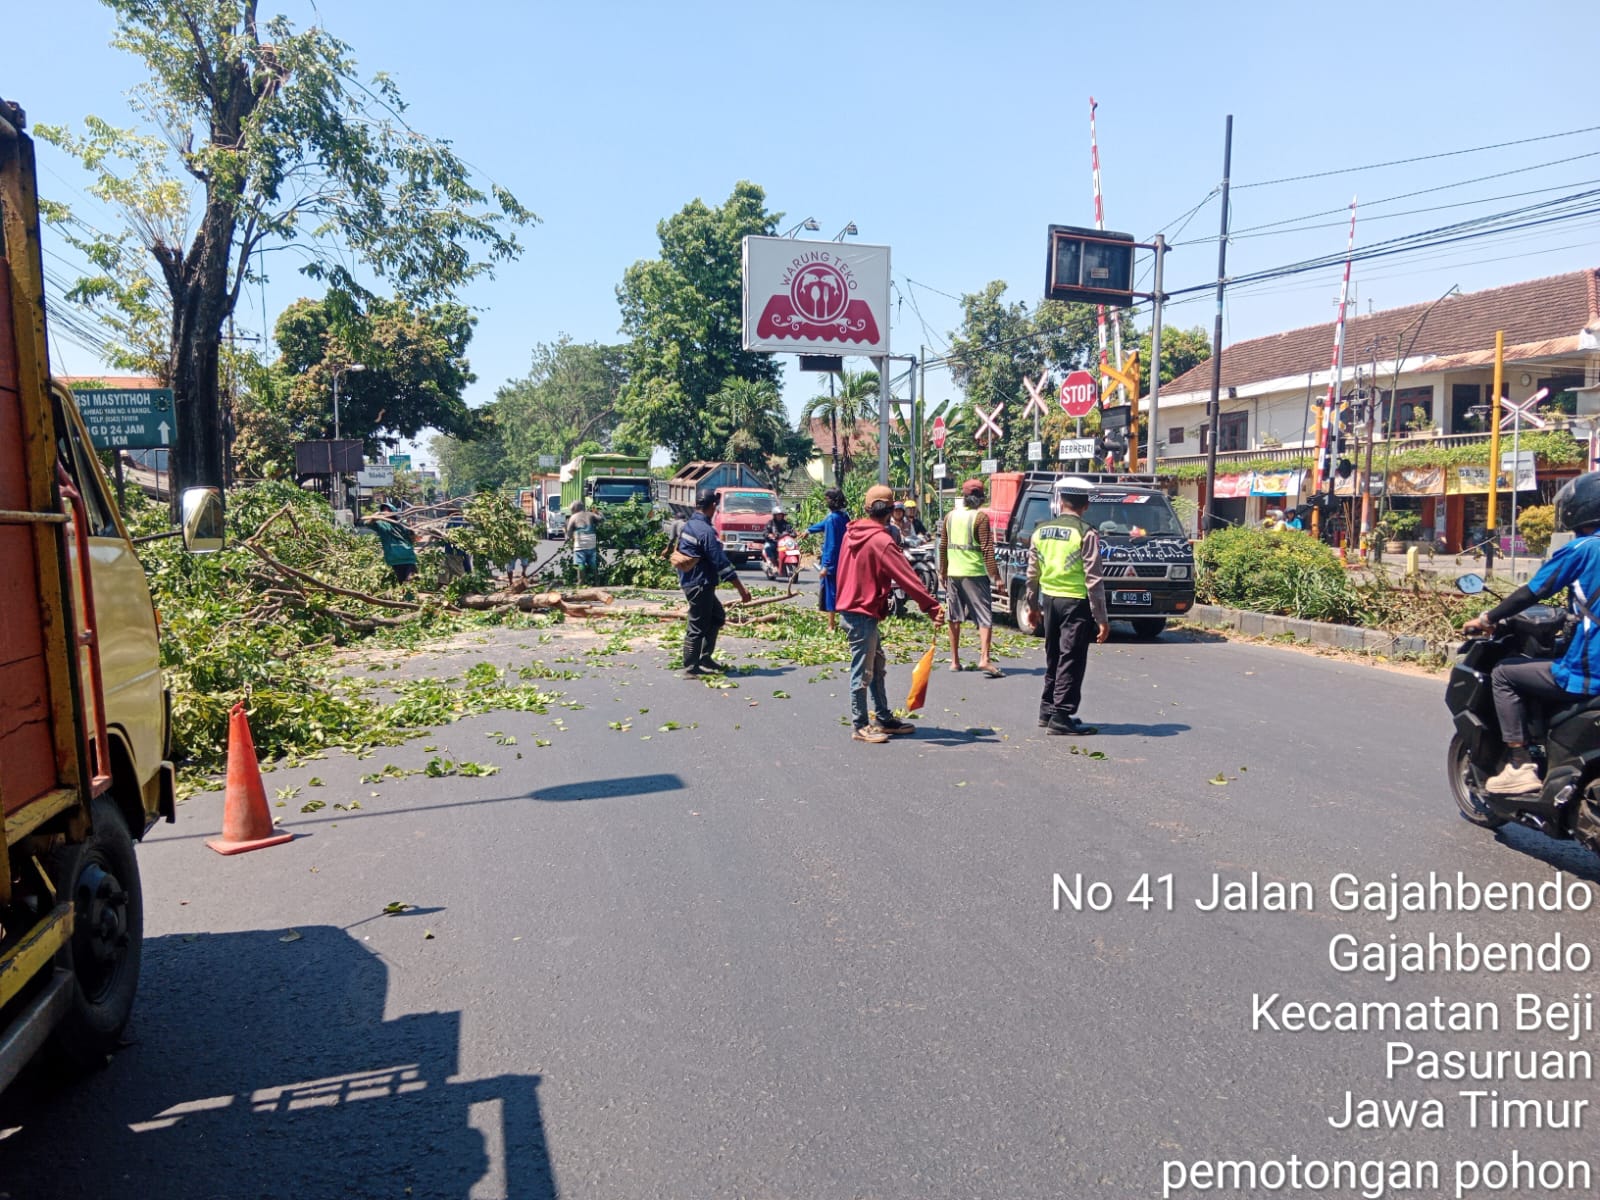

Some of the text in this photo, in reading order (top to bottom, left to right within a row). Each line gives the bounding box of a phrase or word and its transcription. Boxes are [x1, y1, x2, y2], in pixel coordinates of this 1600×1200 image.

[780, 251, 858, 290] WARUNG TEKO
[75, 394, 151, 407] RSI MASYITHOH
[1062, 385, 1095, 404] STOP
[110, 425, 121, 434] 24
[124, 425, 145, 434] JAM
[104, 436, 128, 445] 1 KM
[1060, 444, 1093, 455] BERHENTI
